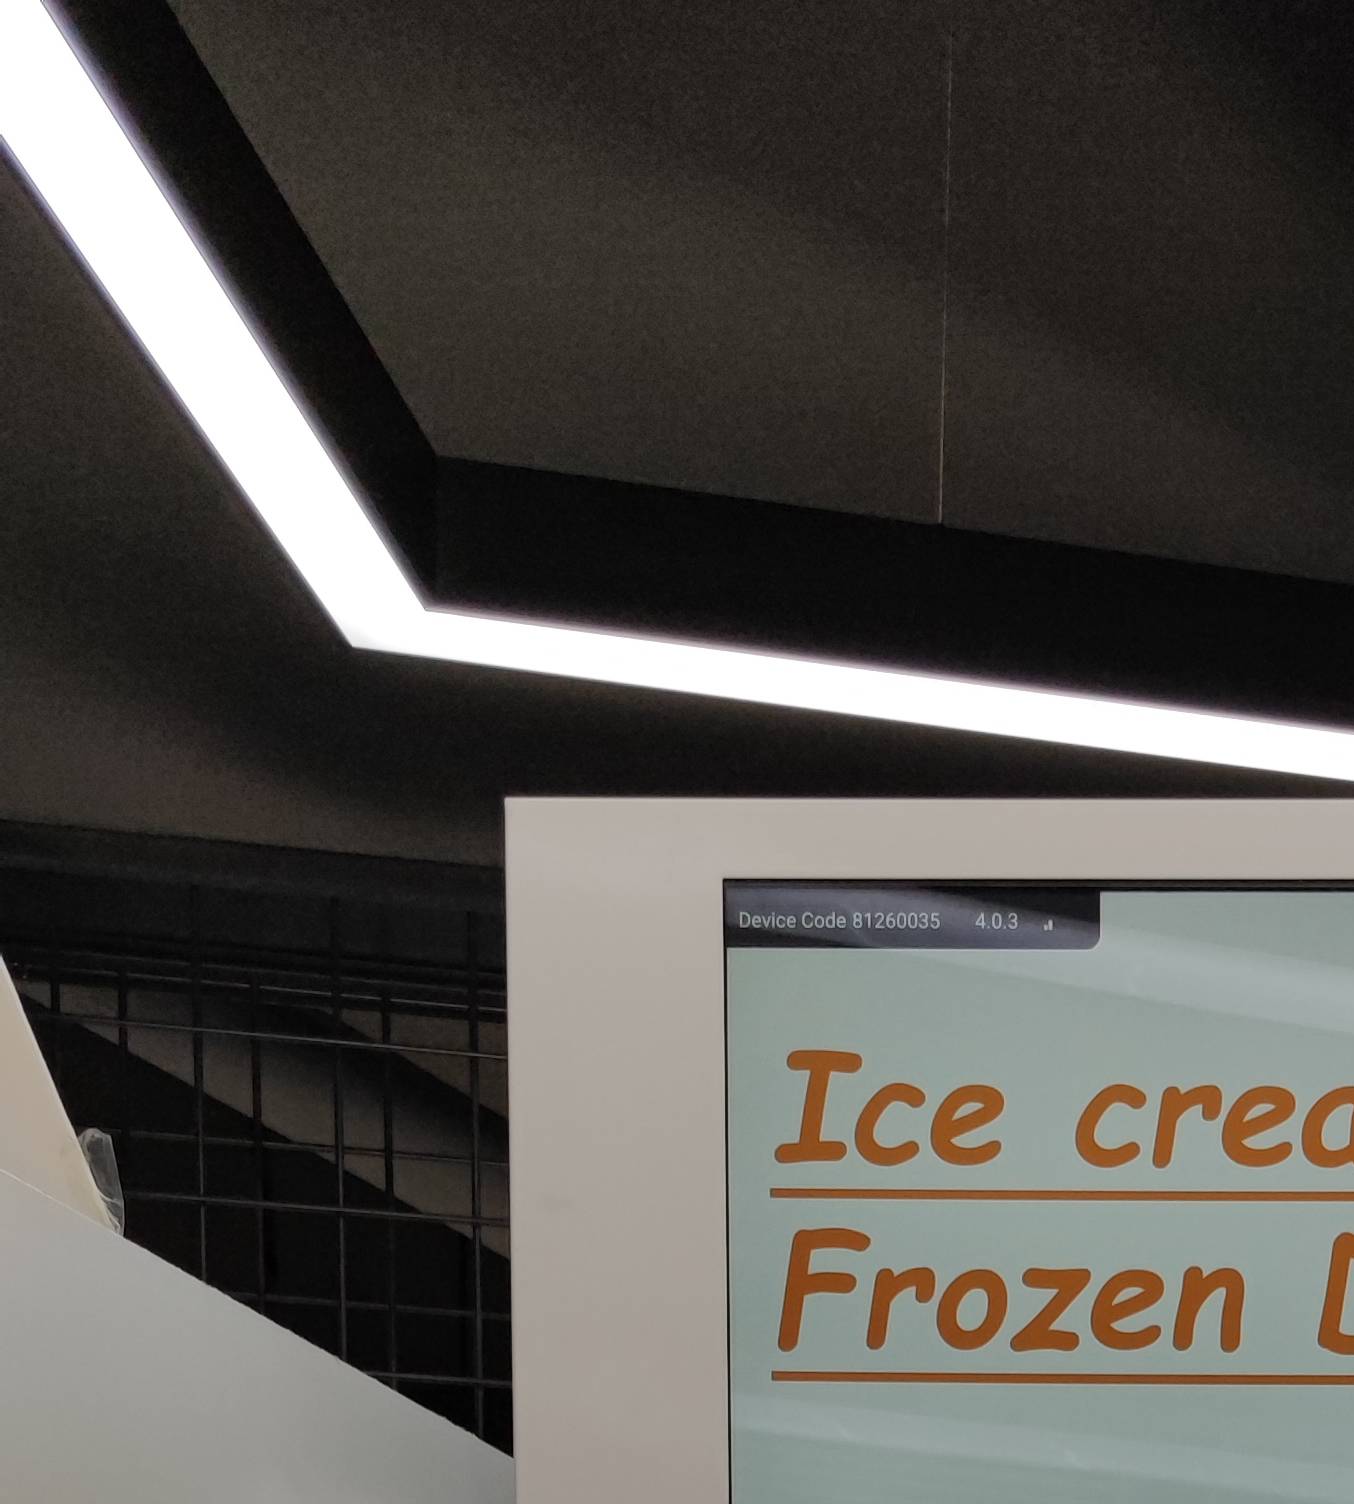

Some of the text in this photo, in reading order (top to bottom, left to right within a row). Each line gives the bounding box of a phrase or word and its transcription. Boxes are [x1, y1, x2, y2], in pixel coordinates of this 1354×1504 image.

[739, 912, 1019, 930] Device Code 81260035 4.0.3
[774, 1049, 1005, 1166] Ice
[778, 1228, 1245, 1352] Frozen
